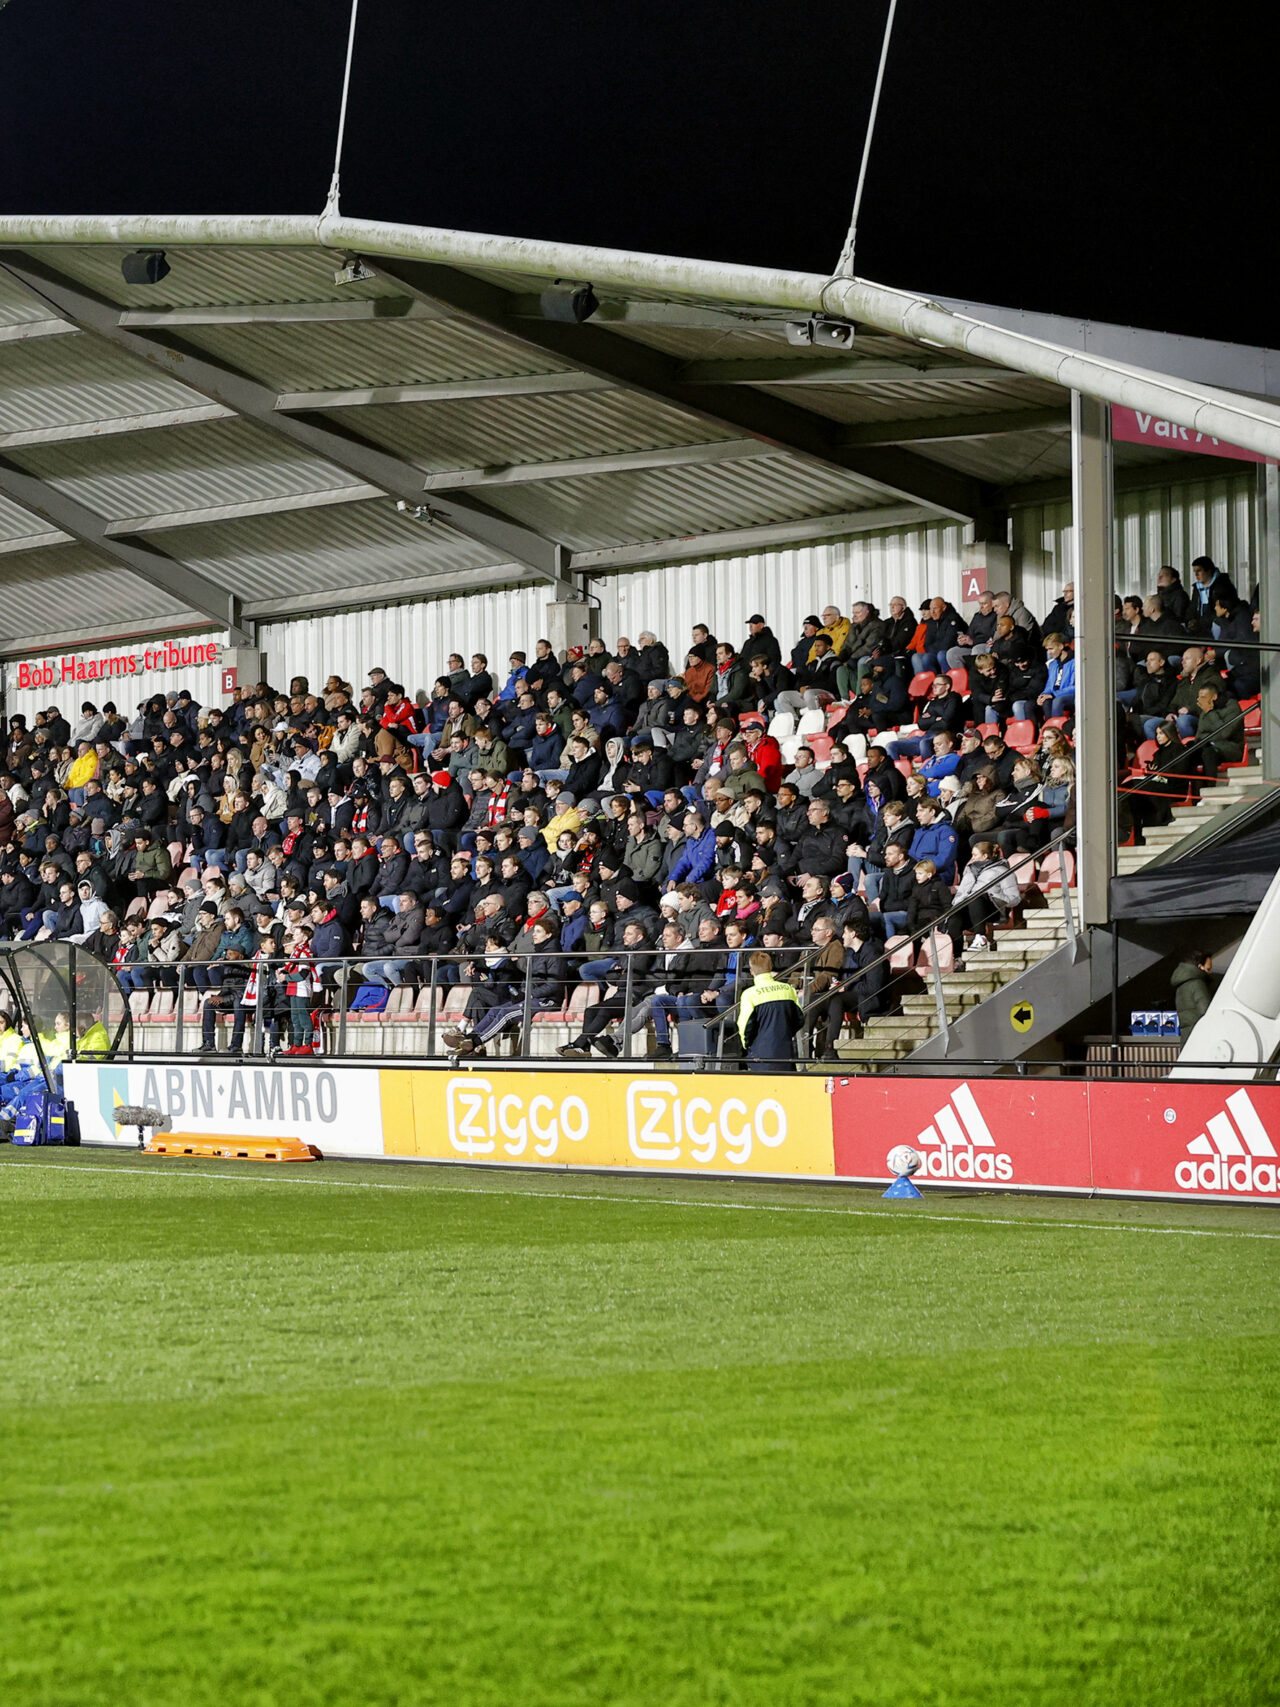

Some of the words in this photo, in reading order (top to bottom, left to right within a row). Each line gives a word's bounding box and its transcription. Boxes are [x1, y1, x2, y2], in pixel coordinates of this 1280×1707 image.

[967, 577, 980, 597] A
[18, 662, 54, 688] Bob
[61, 655, 136, 683] Haarms
[144, 641, 217, 670] tribune
[225, 674, 233, 689] B
[756, 984, 791, 995] STEWARD
[457, 1093, 589, 1157] Ziggo
[639, 1096, 787, 1164] Ziggo
[1174, 1153, 1280, 1193] adida
